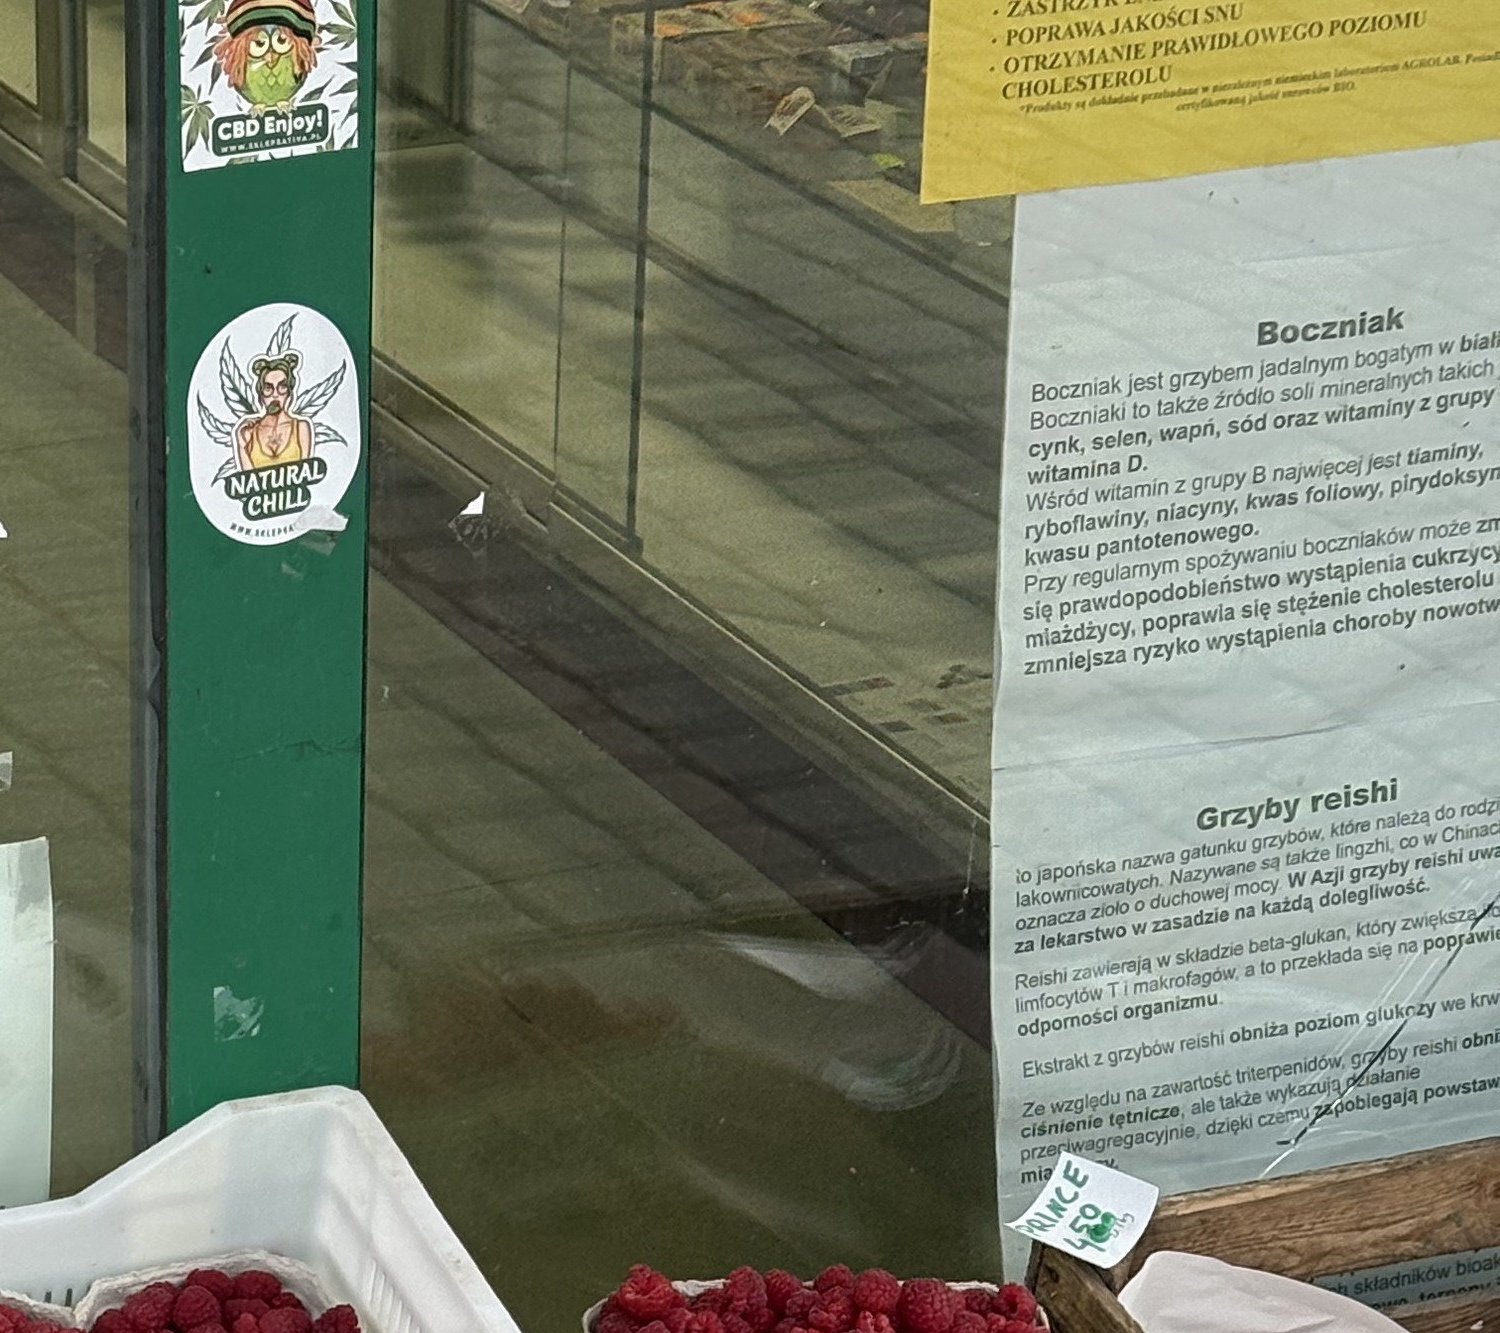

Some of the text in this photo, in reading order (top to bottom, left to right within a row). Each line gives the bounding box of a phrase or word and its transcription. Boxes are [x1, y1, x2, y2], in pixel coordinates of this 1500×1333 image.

[1004, 11, 1427, 74] OTRZYMANIE PRAWIDŁOWEGO POZIOMU
[1006, 3, 1244, 46] POPRAWA JAKOŚCI SNU
[1002, 65, 1173, 100] CHOLESTEROLU
[218, 109, 322, 140] CBD Enjoy!
[1257, 307, 1405, 346] Boczniak
[1030, 359, 1494, 430] Boczniaki także źródło soli mineralnych takich
[1031, 342, 1433, 402] Boczniak jest grzybem jadalnym bogatym
[1028, 387, 1496, 461] cynk, selen, wapń, sód oraz witaminy grupy
[230, 460, 324, 496] NATURAL
[1026, 443, 1483, 512] Wśród witamin grupy najwięcej jest tiaminy,
[1028, 454, 1148, 485] witamina D.
[248, 488, 308, 516] CHILL
[1025, 481, 1383, 543] ryboflawiny, niacyny, kwas foliowy,
[1024, 519, 1471, 594] Przy regularnym spożywaniu boczniaków może
[1025, 522, 1259, 566] kwasu pantotenowego.
[1023, 554, 1406, 623] się prawdopodobieństwo wystąpienia
[1026, 570, 1494, 649] miażdżycy, poprawia się stężenie cholesterolu
[1024, 608, 1416, 675] zmniejsza ryzyko wystąpienia choroby
[1196, 778, 1397, 830] Grzyby reishi
[1037, 811, 1431, 885] japońska nazwa gatunku należą
[1170, 847, 1330, 886] Nazywane także
[1016, 848, 1463, 930] oznacza duchowej Azji grzyby reishi
[1040, 876, 1431, 950] lekarstwo zasadzie każdą dolegliwość.
[1015, 968, 1067, 990] Reishi
[1072, 954, 1152, 982] zawierają
[1176, 941, 1244, 966] składzie
[1356, 918, 1396, 938] który
[1401, 907, 1477, 931] zwiększa
[1016, 944, 1392, 1013] limfocytów przekłada się
[1018, 1006, 1118, 1037] odporności
[1023, 1011, 1360, 1078] Ekstrakt grzybów reishi poziom
[1050, 1036, 1458, 1115] względu zawartość reishi
[1021, 1112, 1103, 1139] ciśnienie
[1015, 1160, 1089, 1237] PRINCE
[1353, 1266, 1451, 1295] składników
